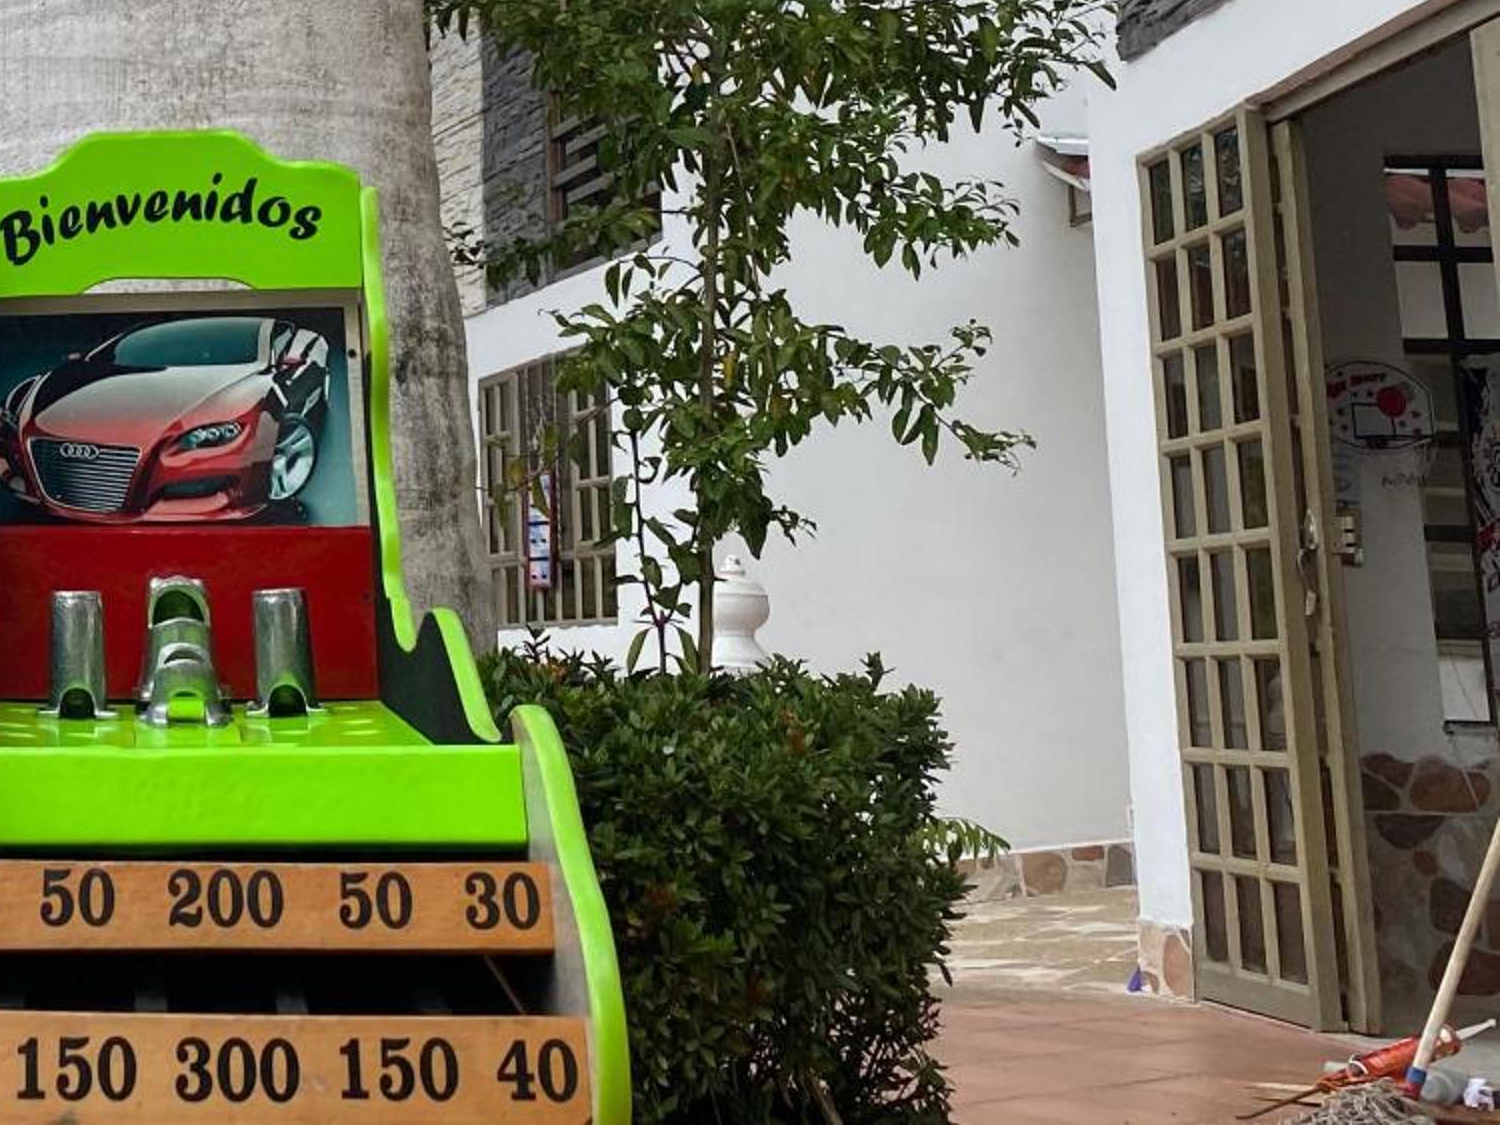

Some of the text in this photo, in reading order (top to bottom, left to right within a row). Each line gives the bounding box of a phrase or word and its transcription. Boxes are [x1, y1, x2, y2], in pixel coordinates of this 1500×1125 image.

[0, 173, 322, 266] Bienvenidos
[41, 869, 115, 927] 50
[168, 869, 283, 928] 200
[340, 872, 412, 929] 50
[465, 872, 540, 930] 30
[18, 1037, 136, 1101] 150
[176, 1037, 299, 1103] 300
[340, 1038, 458, 1101] 150
[497, 1039, 578, 1103] 40
